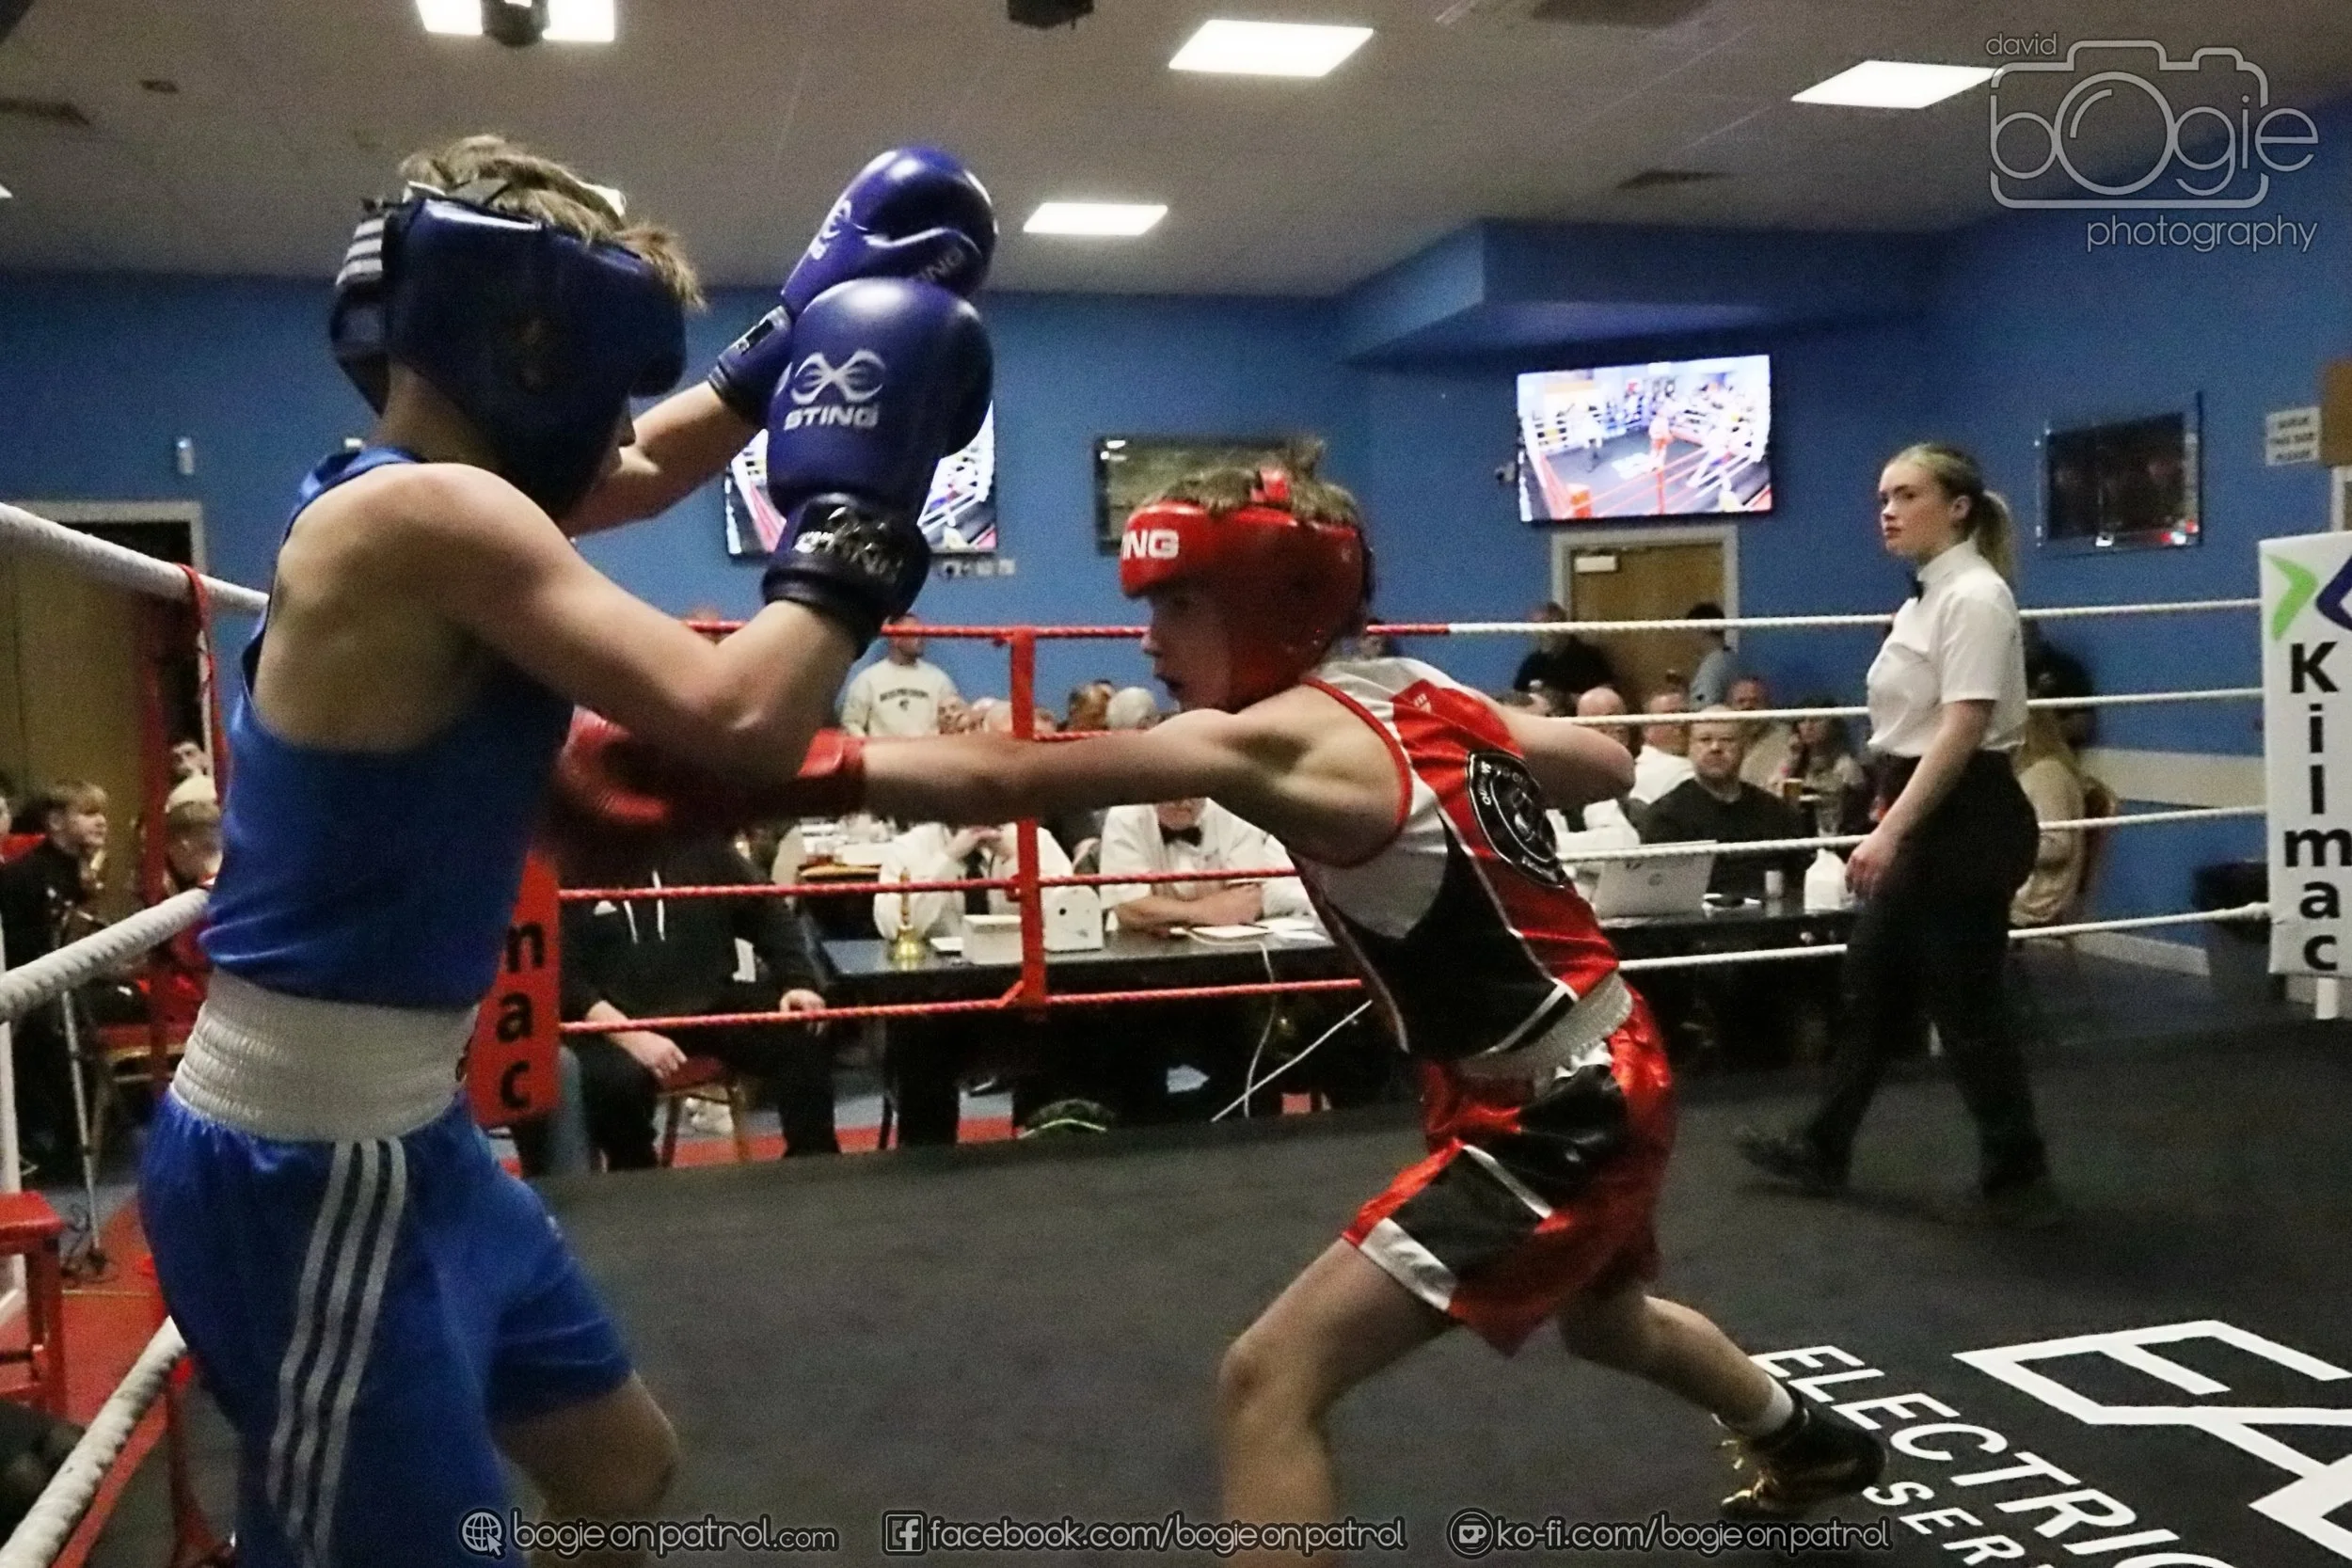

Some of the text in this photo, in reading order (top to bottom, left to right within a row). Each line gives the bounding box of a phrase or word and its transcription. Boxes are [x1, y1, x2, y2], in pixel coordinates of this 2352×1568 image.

[784, 404, 879, 431] STING
[1121, 529, 1180, 561] ING
[2283, 641, 2352, 972] Kilmac
[496, 922, 546, 1110] mac
[1862, 1481, 2055, 1568] SER
